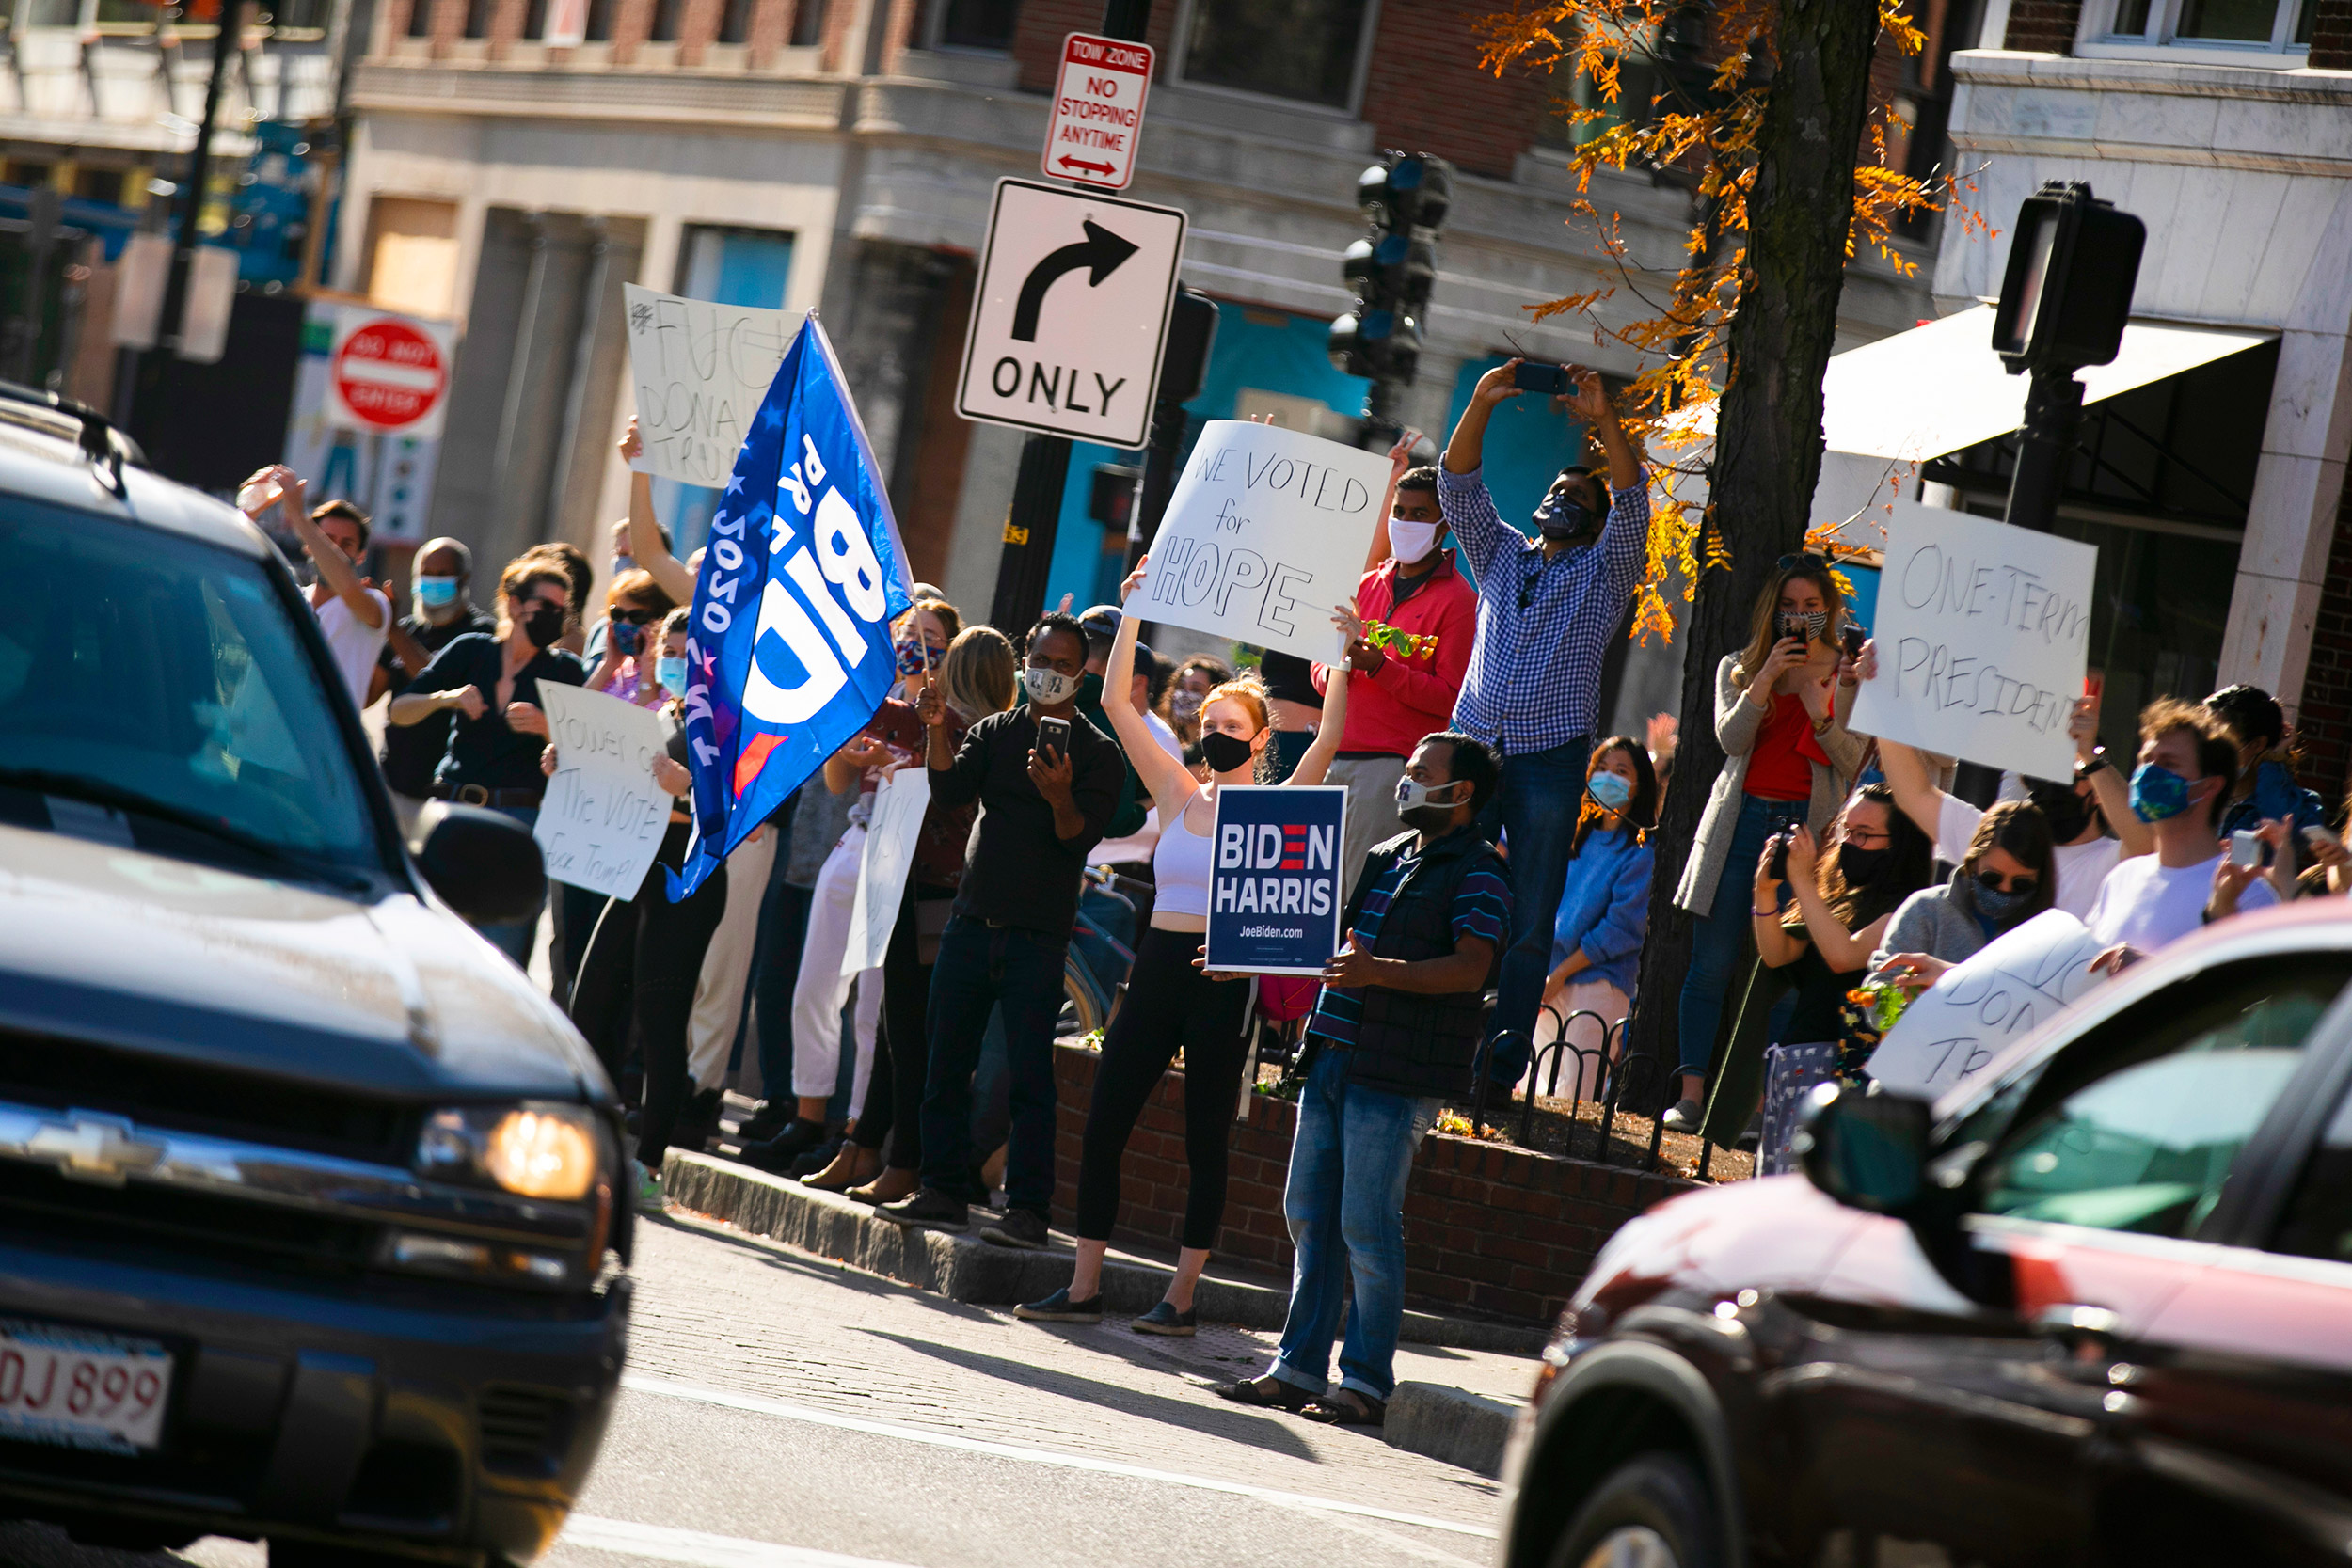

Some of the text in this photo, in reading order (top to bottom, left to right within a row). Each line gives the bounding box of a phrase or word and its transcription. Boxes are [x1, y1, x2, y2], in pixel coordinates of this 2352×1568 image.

[1073, 40, 1148, 70] TOW ZONE
[1085, 76, 1118, 98] NO
[1059, 97, 1136, 127] STOPPING
[1059, 124, 1126, 152] ANYTIME
[992, 356, 1127, 417] ONLY
[642, 381, 758, 443] DONA
[1194, 448, 1369, 513] WE VOTED
[1216, 497, 1250, 534] for
[1152, 535, 1313, 637] HOPE
[733, 484, 887, 800] BID
[1219, 824, 1334, 870] BIDEN
[1216, 877, 1331, 916] HARRIS
[1239, 925, 1303, 939] JoeBiden.com
[1926, 1037, 1993, 1084] TR
[67, 1360, 161, 1420] 899
